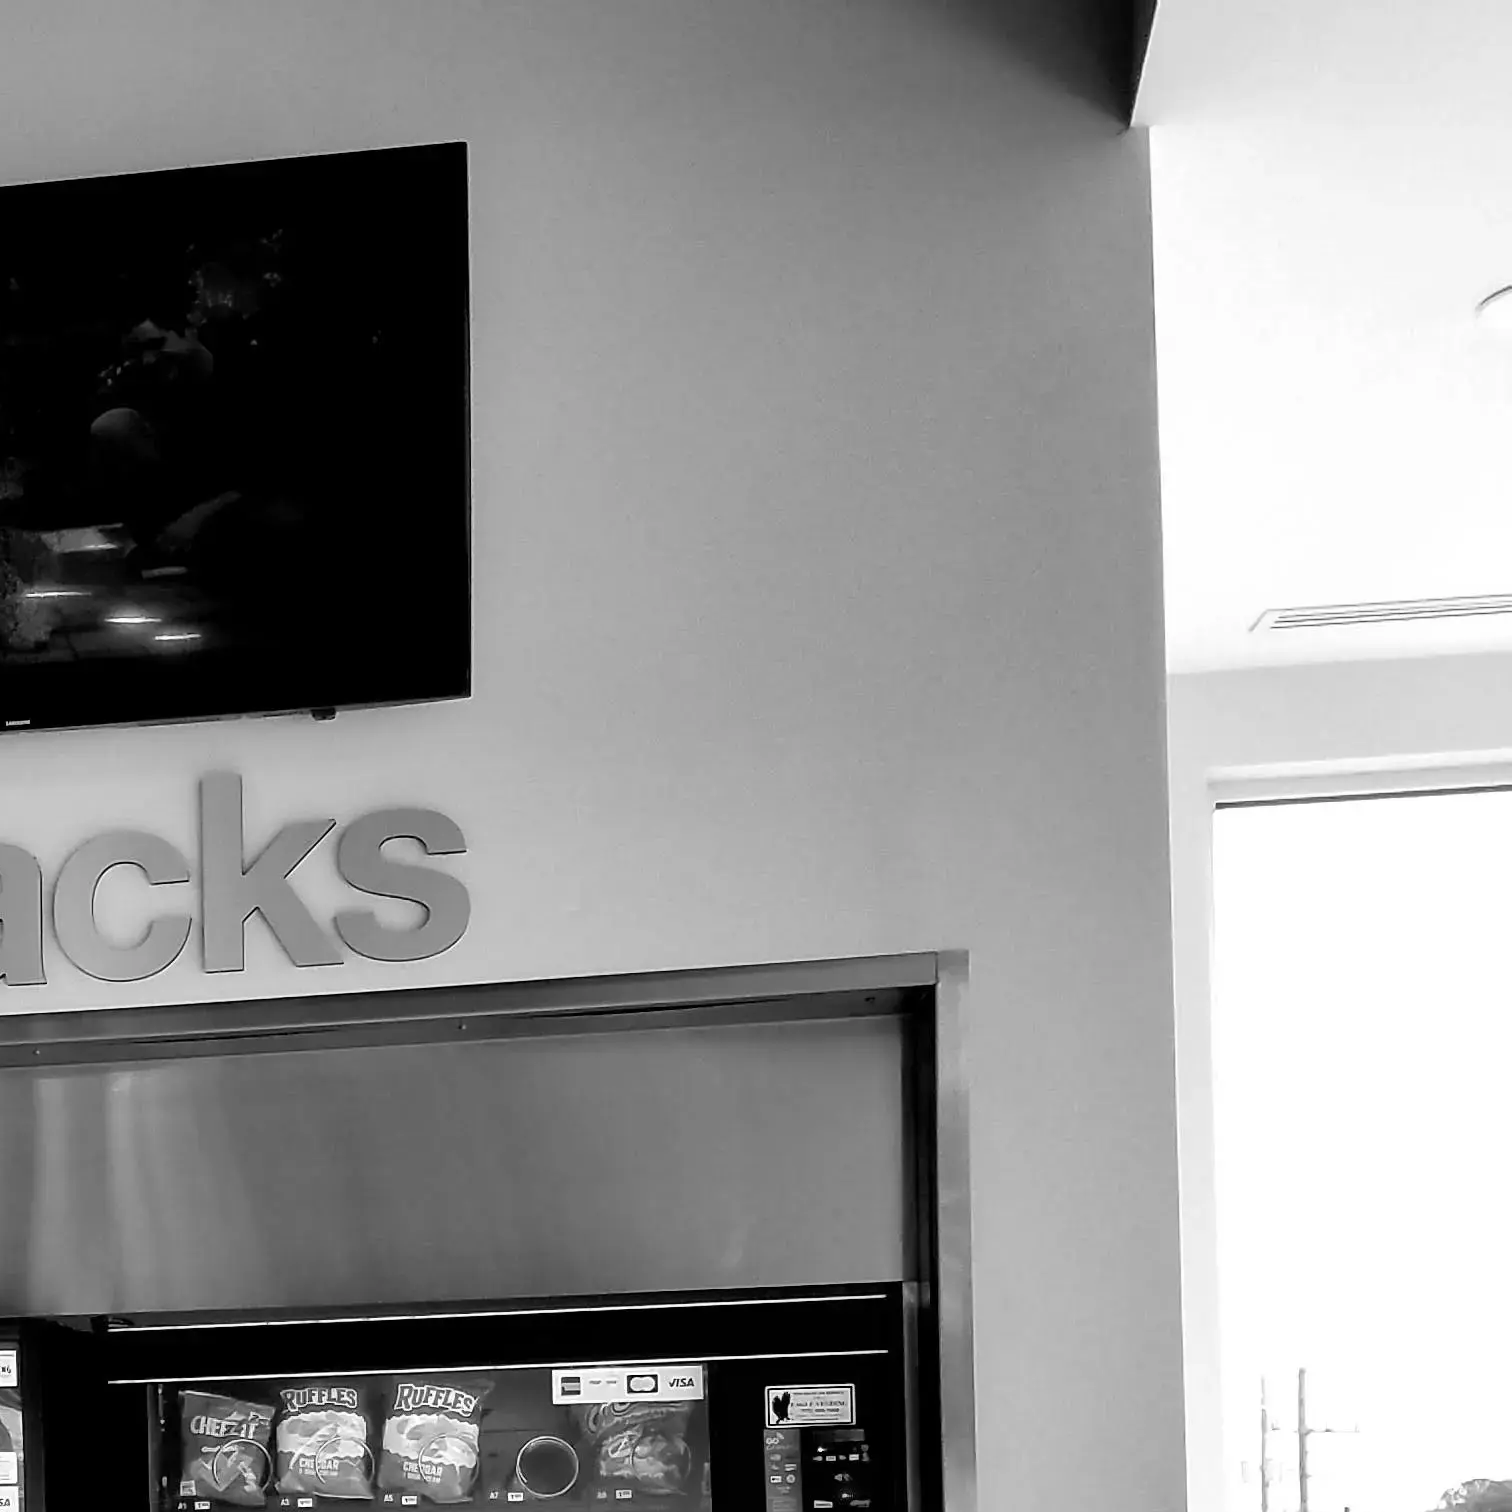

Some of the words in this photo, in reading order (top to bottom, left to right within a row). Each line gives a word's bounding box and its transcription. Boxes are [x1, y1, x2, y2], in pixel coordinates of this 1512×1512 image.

[668, 1378, 695, 1388] VISA
[280, 1388, 358, 1411] RUFFLES
[394, 1384, 476, 1417] RUFFLES
